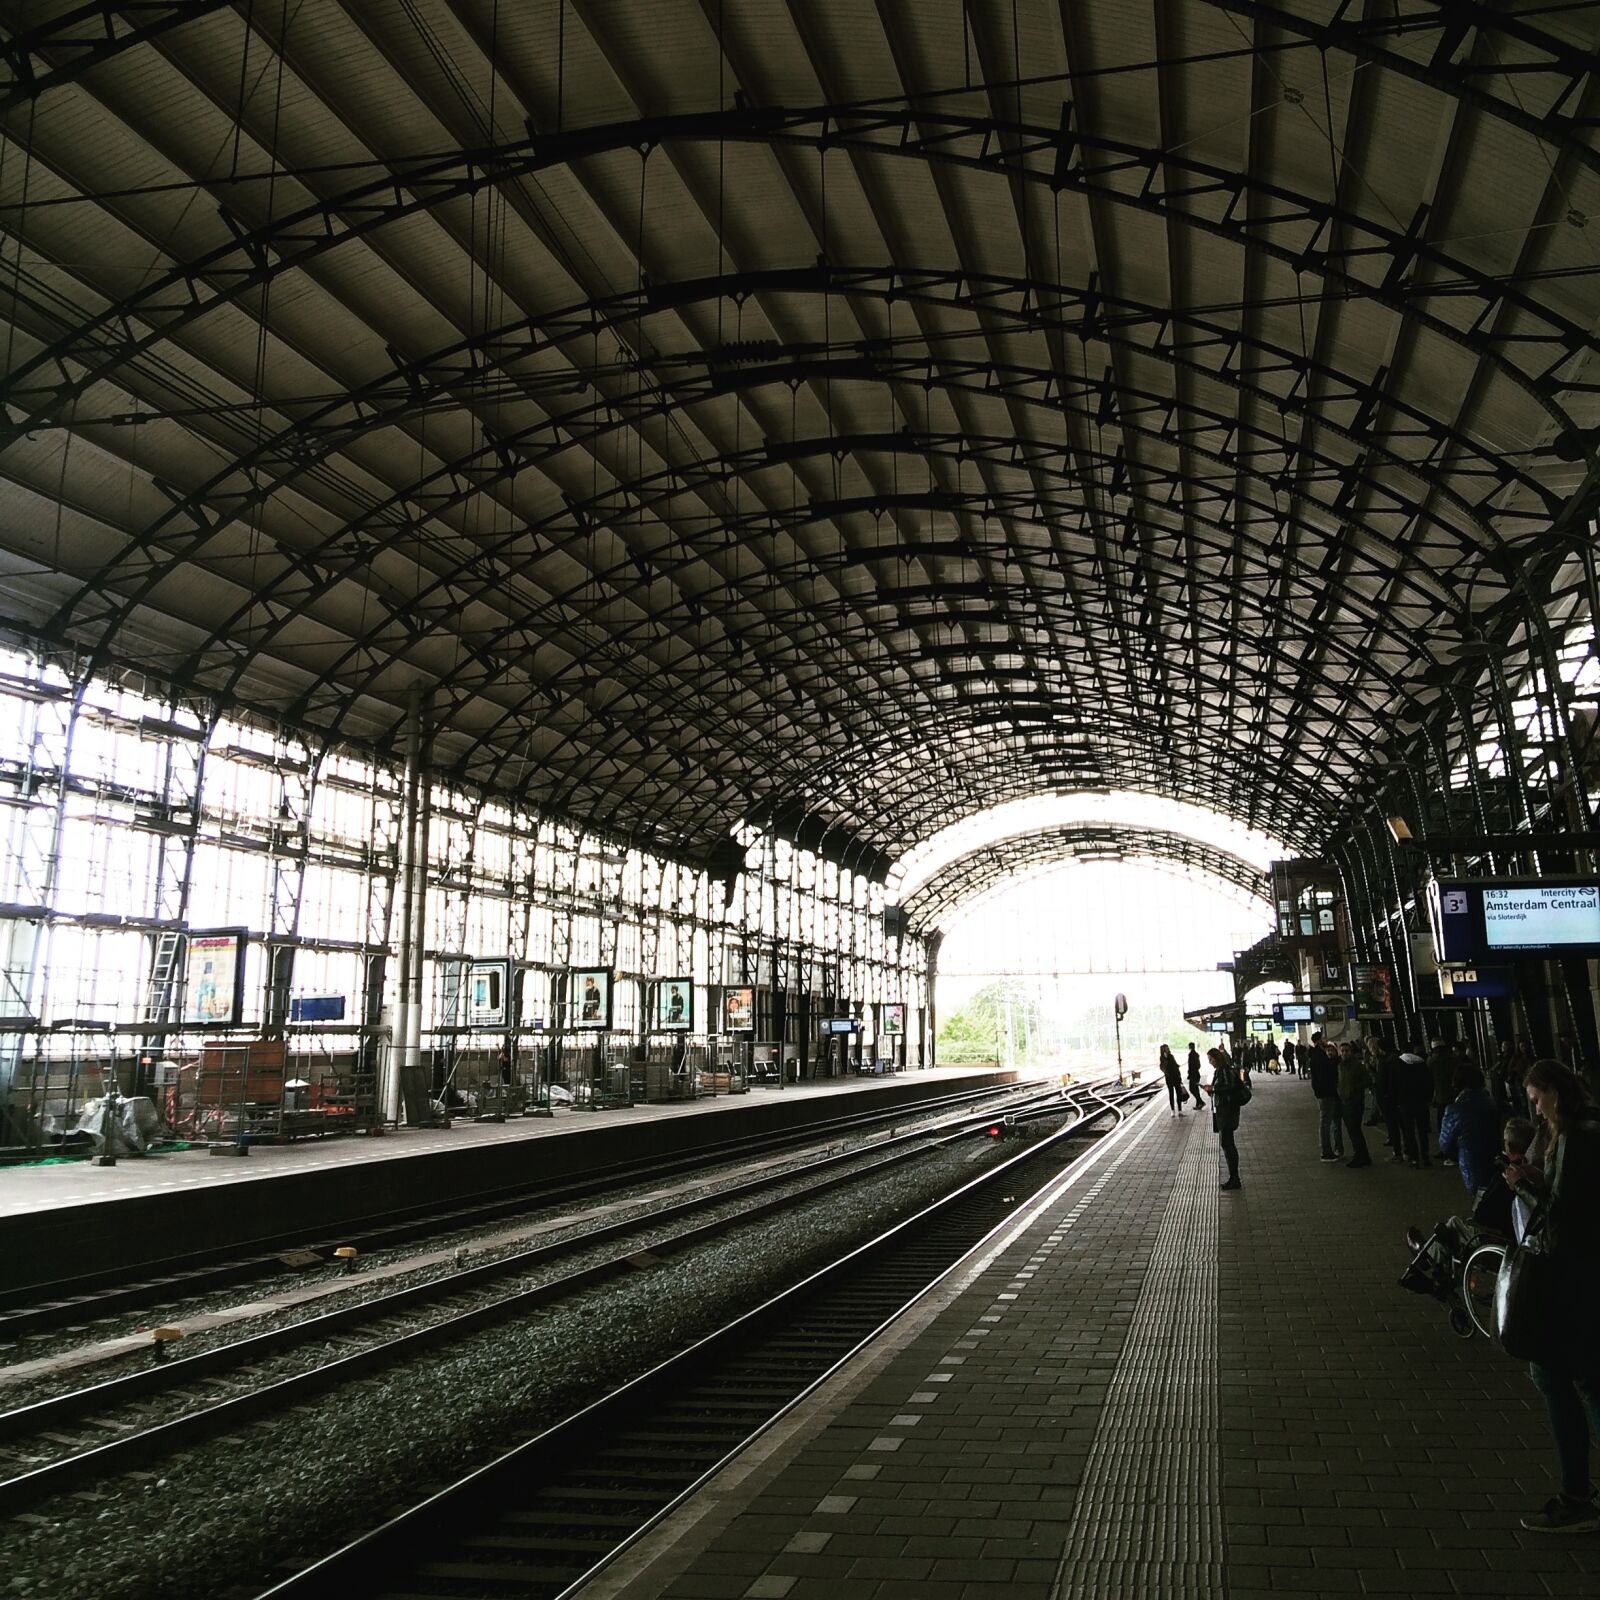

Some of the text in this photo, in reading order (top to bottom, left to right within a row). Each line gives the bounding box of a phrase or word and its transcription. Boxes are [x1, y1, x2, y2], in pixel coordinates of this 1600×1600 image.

[1486, 888, 1577, 899] 16:32 Intercity
[1486, 898, 1597, 911] Amsterdam Centraal
[1498, 913, 1527, 921] Sloterdijk
